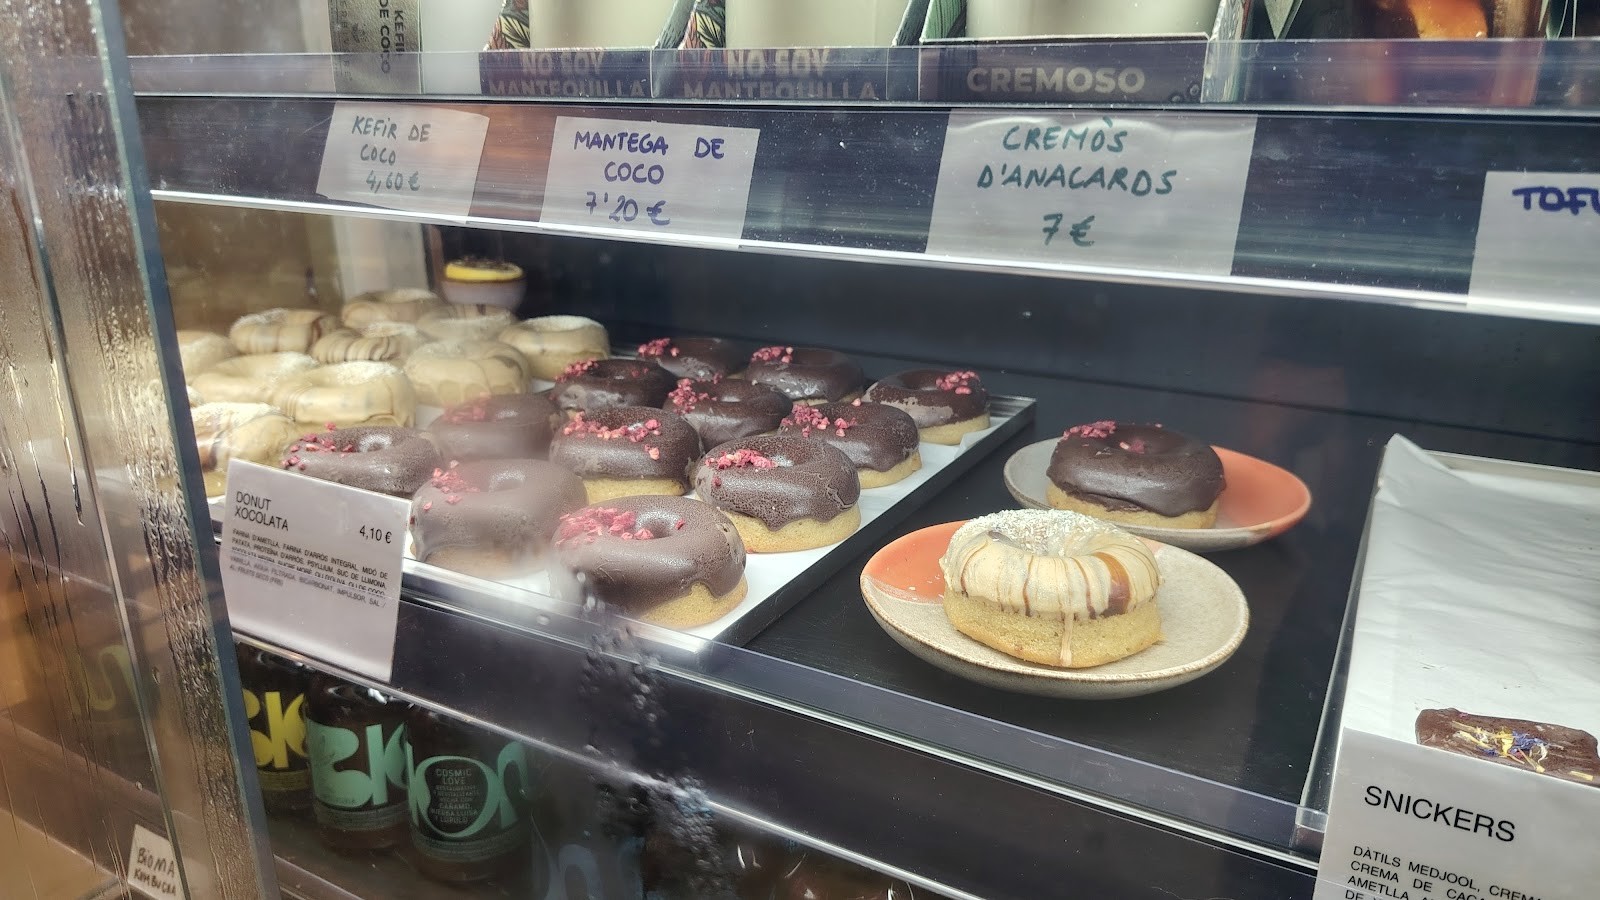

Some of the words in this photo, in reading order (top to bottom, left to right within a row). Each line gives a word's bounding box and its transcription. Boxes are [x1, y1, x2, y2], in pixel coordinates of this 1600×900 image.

[966, 67, 1146, 94] CREMOSO
[408, 124, 431, 142] DE
[360, 144, 396, 165] COCO
[574, 131, 669, 156] MANTEGA
[694, 137, 725, 159] DE
[366, 170, 404, 193] 4,60
[408, 171, 420, 191] €
[604, 161, 665, 185] COCO
[977, 163, 1177, 196] D'ANACARDS
[646, 200, 670, 226] €
[1042, 213, 1063, 246] 7
[1069, 215, 1095, 247] €
[236, 491, 272, 510] DONUT
[235, 505, 288, 531] XOCOLATA
[360, 525, 382, 541] 4,10
[385, 531, 392, 543] €
[337, 568, 349, 578] SUC
[380, 571, 389, 579] DE
[369, 598, 380, 607] SAL
[434, 768, 472, 777] COSMIC
[443, 777, 466, 785] LOVE
[1364, 785, 1515, 842] SNICKERS
[1351, 860, 1399, 883] CREMA
[1413, 878, 1433, 893] DE
[1353, 845, 1401, 868] DÀTILS
[1408, 861, 1480, 893] MEDJOOL,
[1345, 889, 1364, 900] DE
[1348, 875, 1409, 900] AMETLLA
